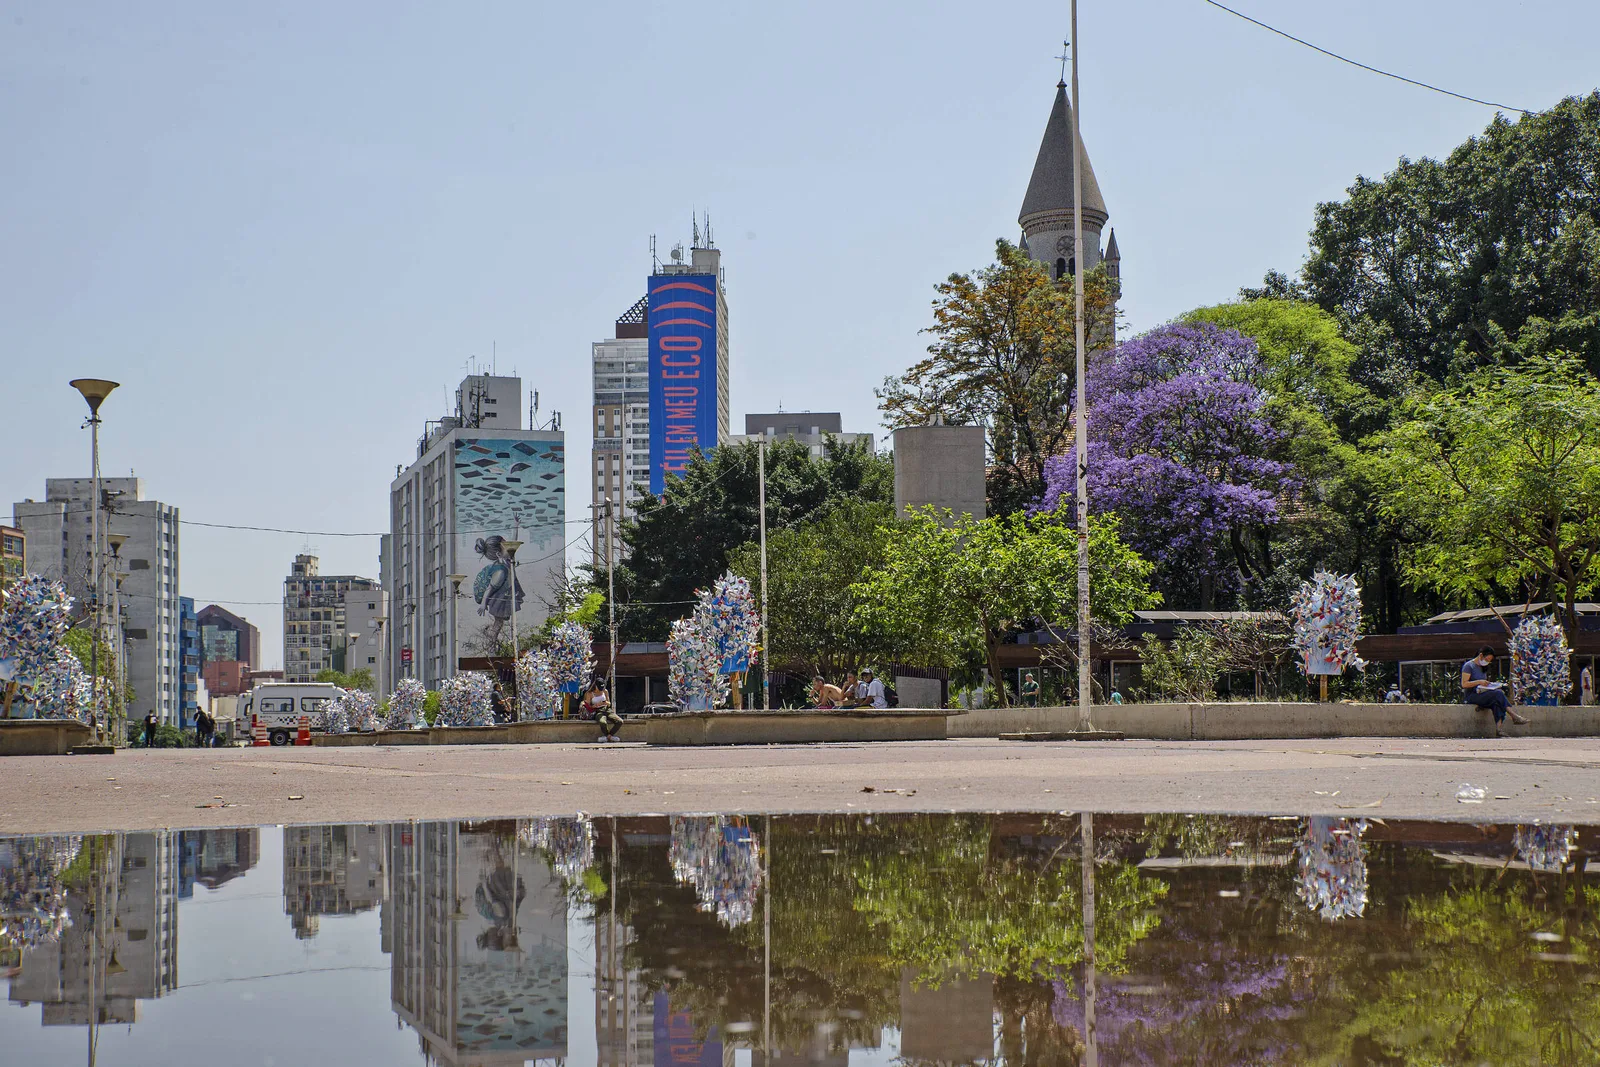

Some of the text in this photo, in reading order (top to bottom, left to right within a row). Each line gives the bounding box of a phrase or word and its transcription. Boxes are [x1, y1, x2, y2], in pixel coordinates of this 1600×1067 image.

[659, 335, 702, 379] ECO
[664, 386, 698, 419] MEU
[665, 425, 698, 442] EM
